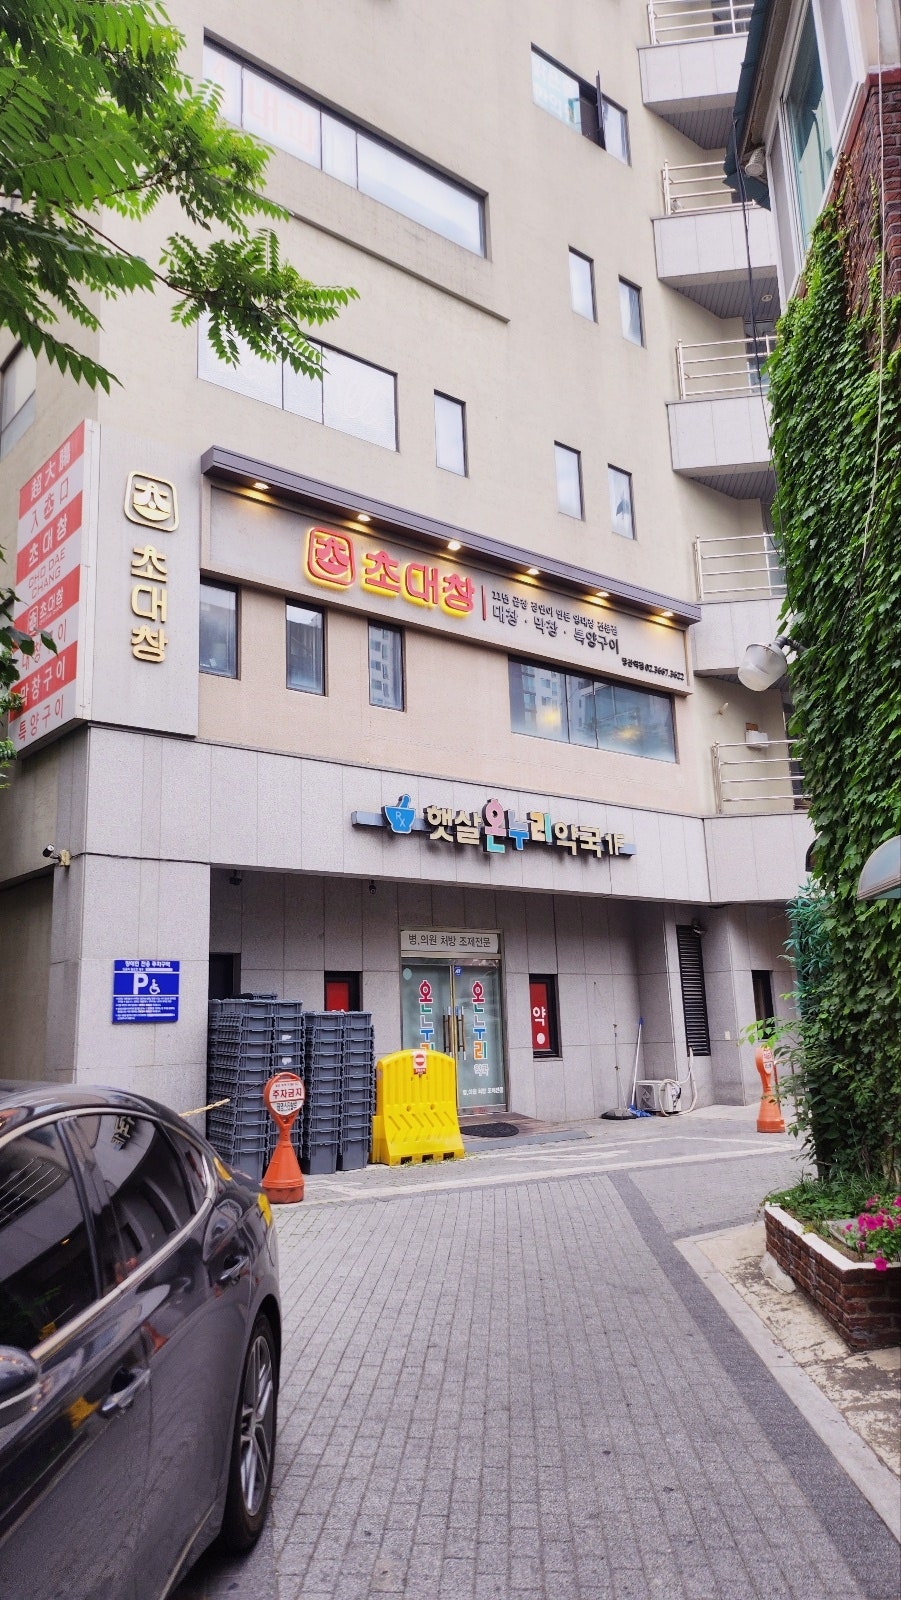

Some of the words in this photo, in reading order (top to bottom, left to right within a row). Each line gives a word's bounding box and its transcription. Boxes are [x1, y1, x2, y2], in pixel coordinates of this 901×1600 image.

[29, 513, 67, 568] 초대창
[32, 565, 61, 599] CHANG
[131, 544, 168, 663] 초대창
[363, 550, 476, 614] 초대창
[492, 604, 519, 627] 대창
[533, 615, 559, 638] 막창
[573, 627, 619, 655] 특양구이
[20, 656, 65, 706] 막창구이
[19, 694, 64, 741] 특양구이
[441, 935, 456, 947] 처방
[459, 936, 491, 948] 조제전문
[133, 973, 149, 995] P
[419, 980, 435, 1050] 온누
[472, 981, 488, 1060] 온누리
[533, 1006, 547, 1026] 약
